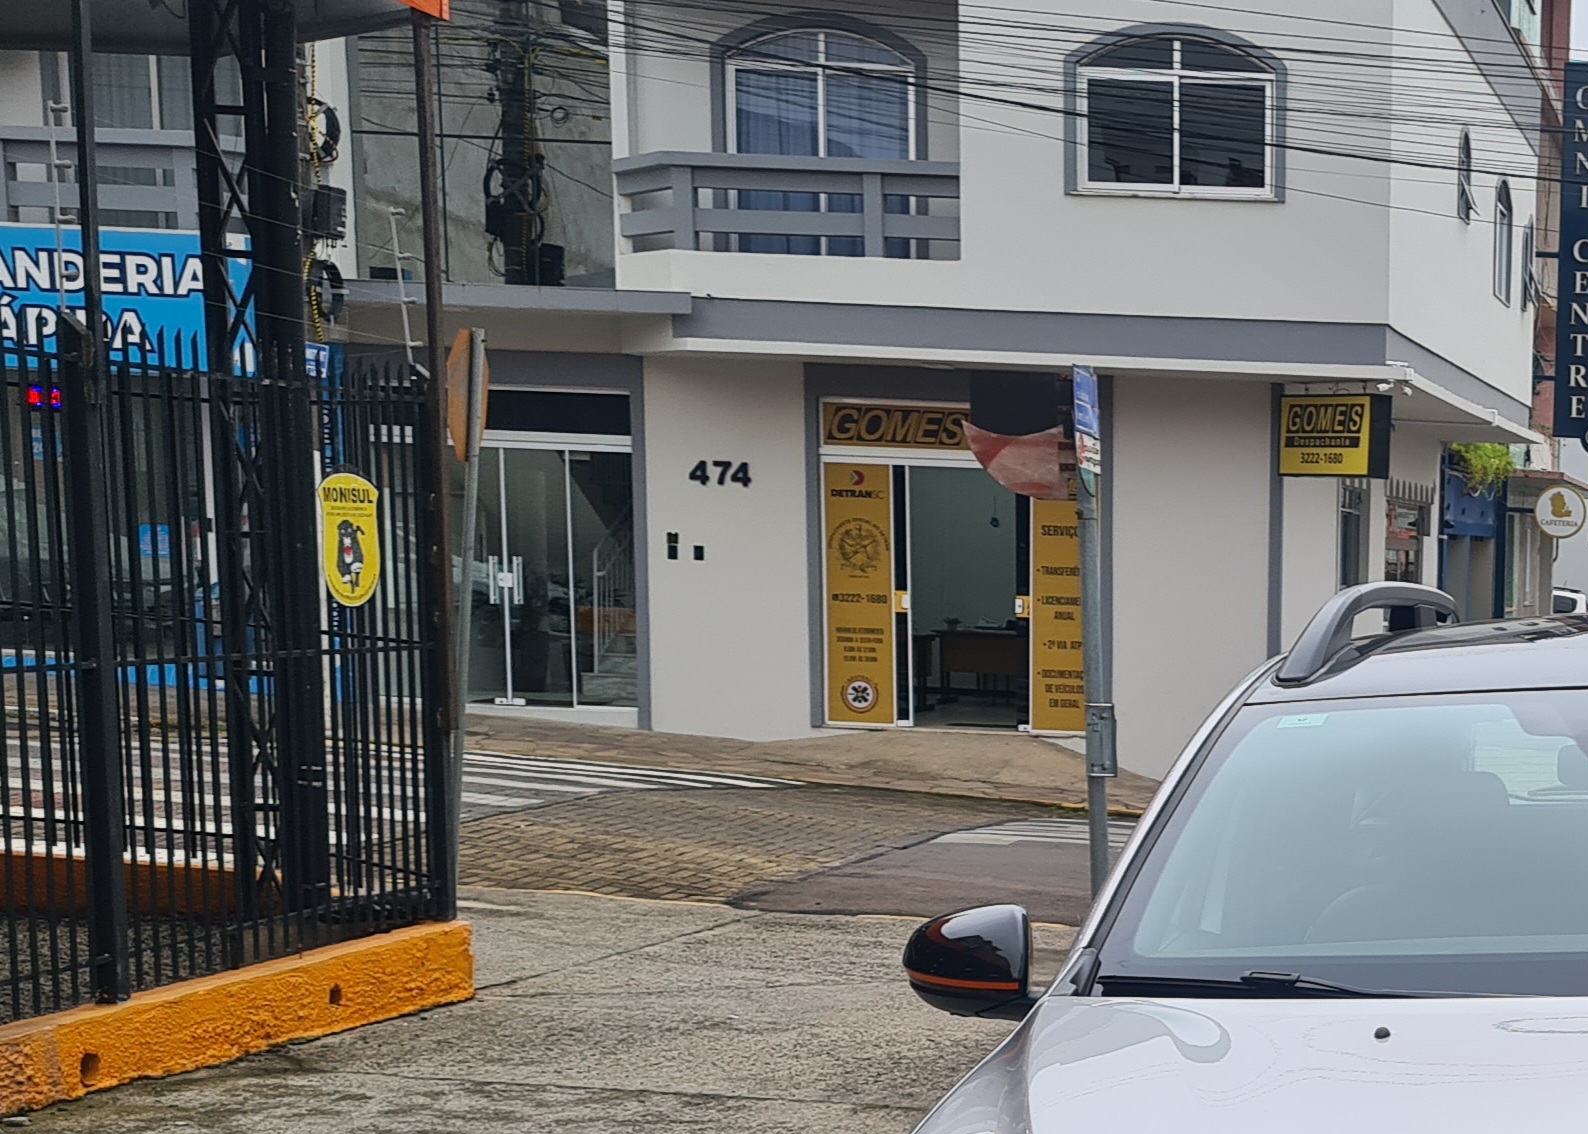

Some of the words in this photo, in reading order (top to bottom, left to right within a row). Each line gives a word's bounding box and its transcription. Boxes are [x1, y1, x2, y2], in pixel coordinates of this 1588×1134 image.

[831, 408, 968, 445] GOMES
[1288, 405, 1362, 432] GOMES
[1293, 436, 1350, 446] Despachante
[1300, 452, 1343, 464] 3222-1680
[689, 460, 752, 488] 474
[323, 486, 374, 504] MONISUL
